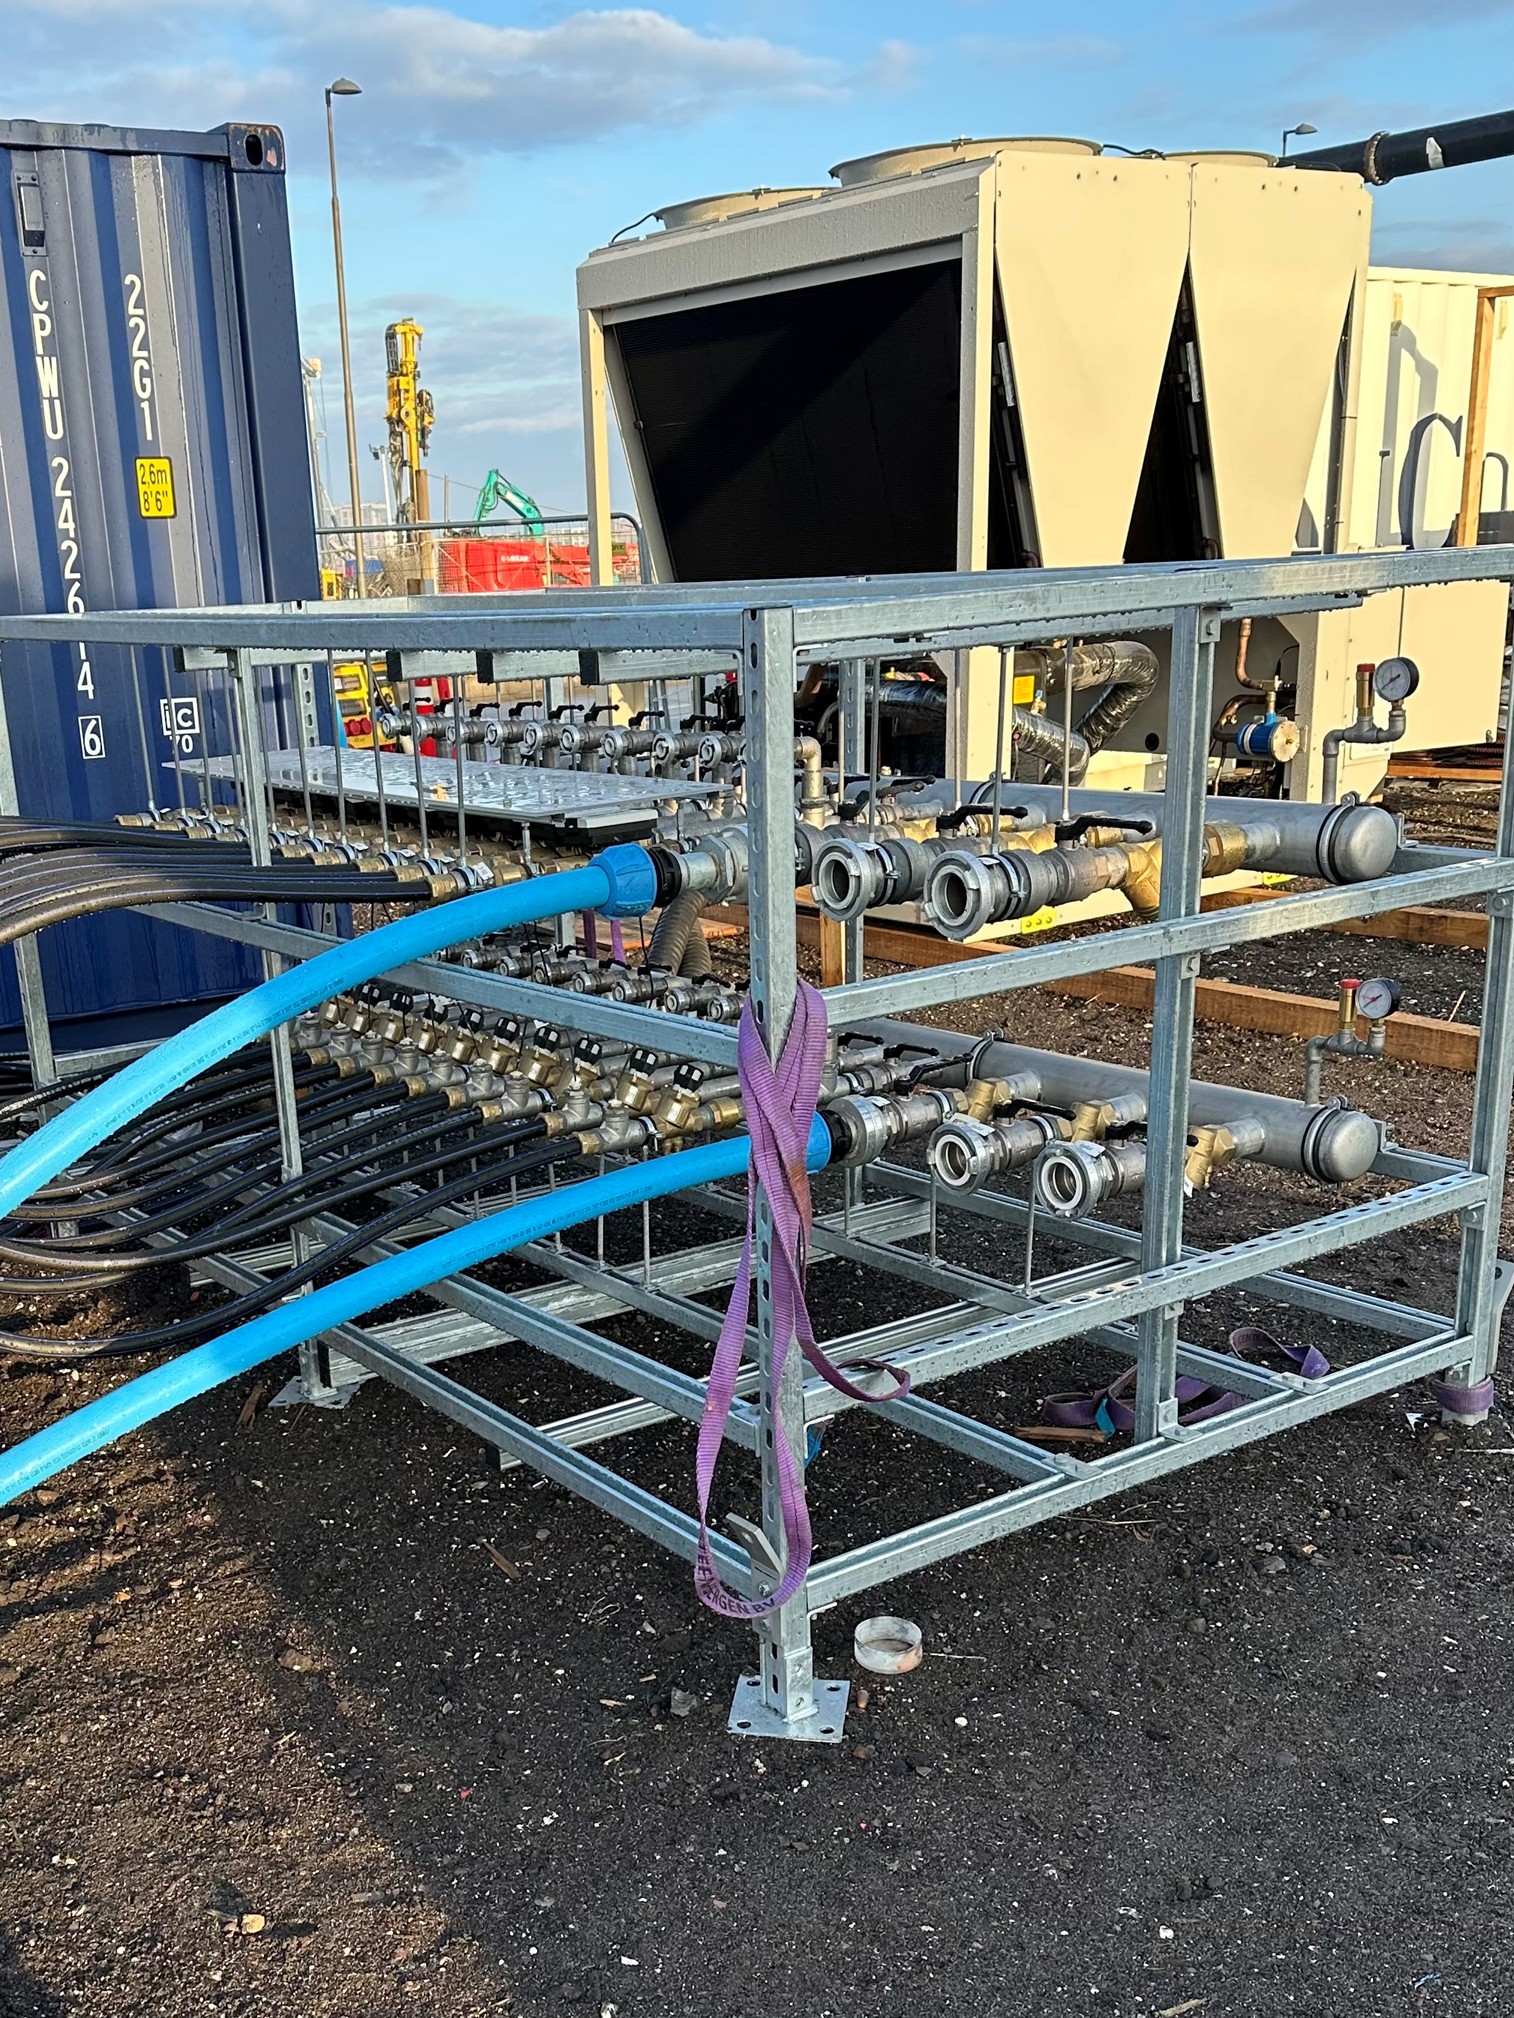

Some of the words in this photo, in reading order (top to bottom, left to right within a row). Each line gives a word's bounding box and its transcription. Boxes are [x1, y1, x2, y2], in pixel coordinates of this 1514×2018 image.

[29, 270, 64, 440] CPWU
[124, 274, 153, 441] 22G1
[752, 1598, 775, 1613] BV
